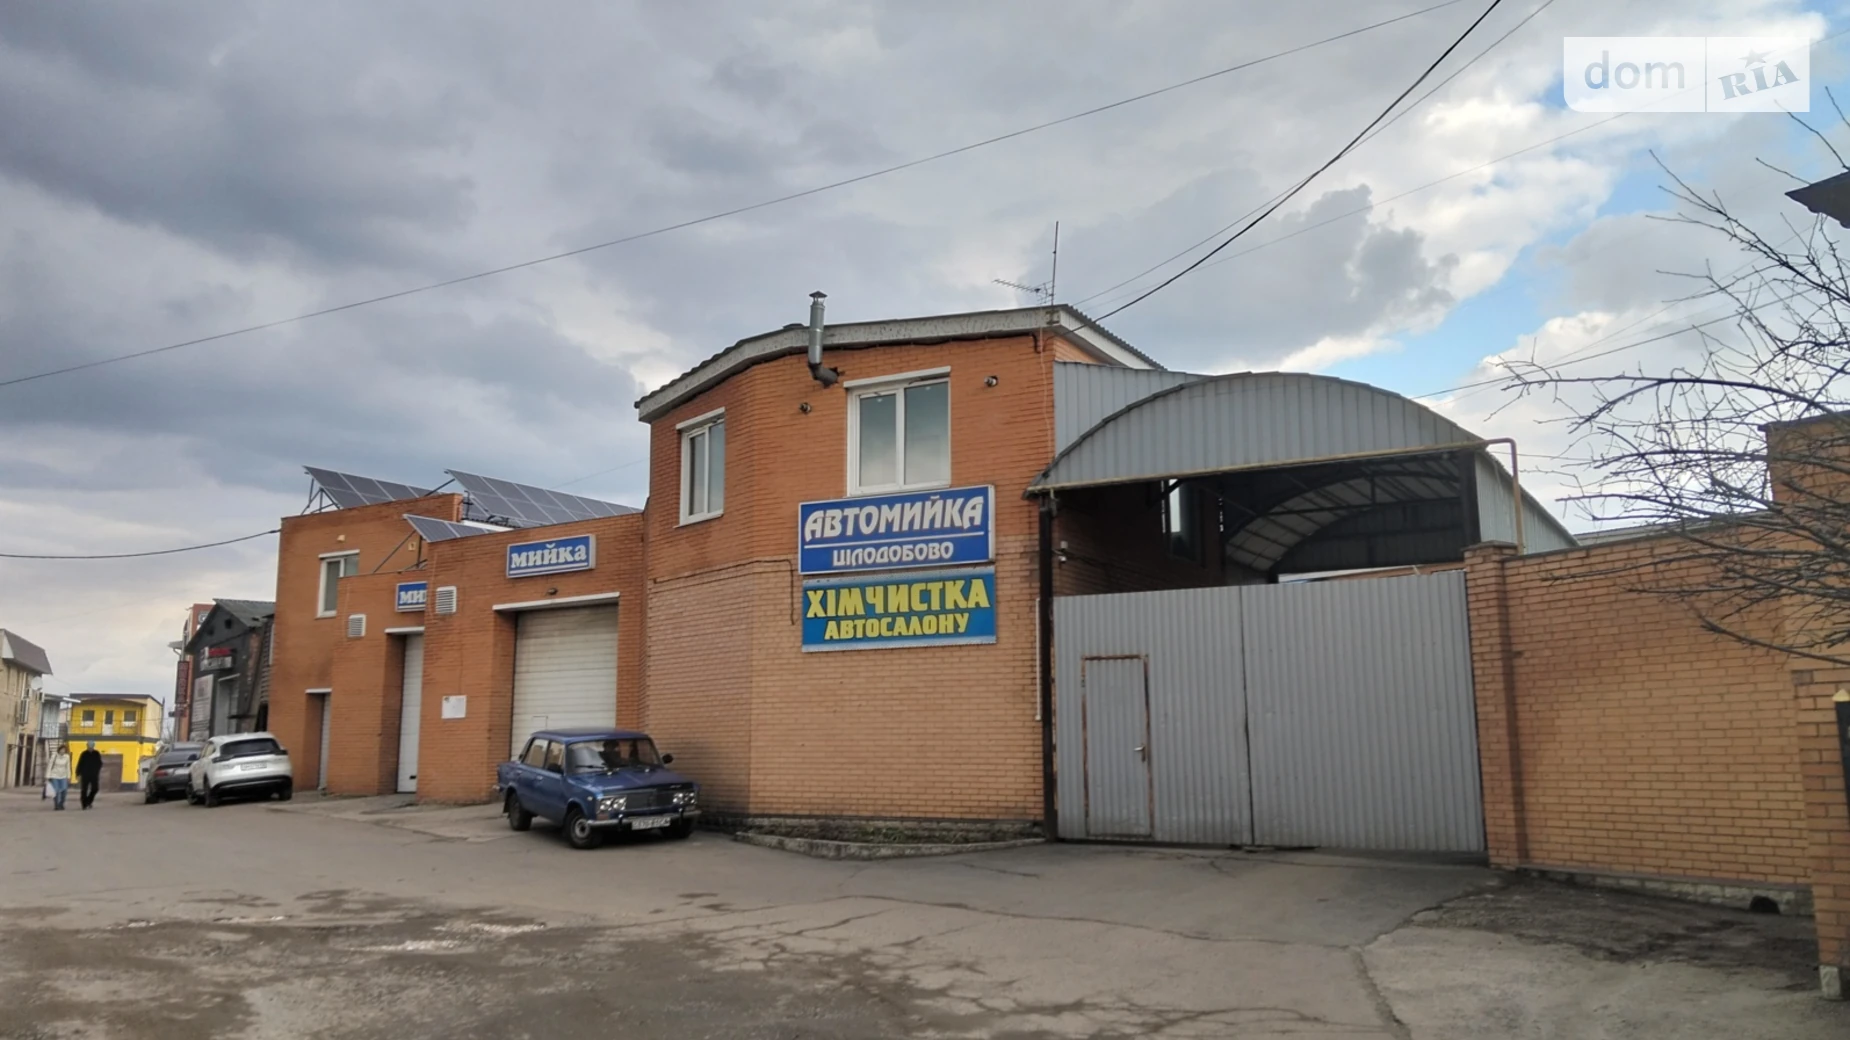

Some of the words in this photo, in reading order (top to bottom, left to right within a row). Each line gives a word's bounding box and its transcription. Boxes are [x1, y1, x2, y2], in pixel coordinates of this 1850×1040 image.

[804, 495, 984, 542] АВТОМИЙКА
[806, 578, 990, 618] ХІМЧИСТКА
[824, 612, 969, 641] АВТОСАЛОНУ
